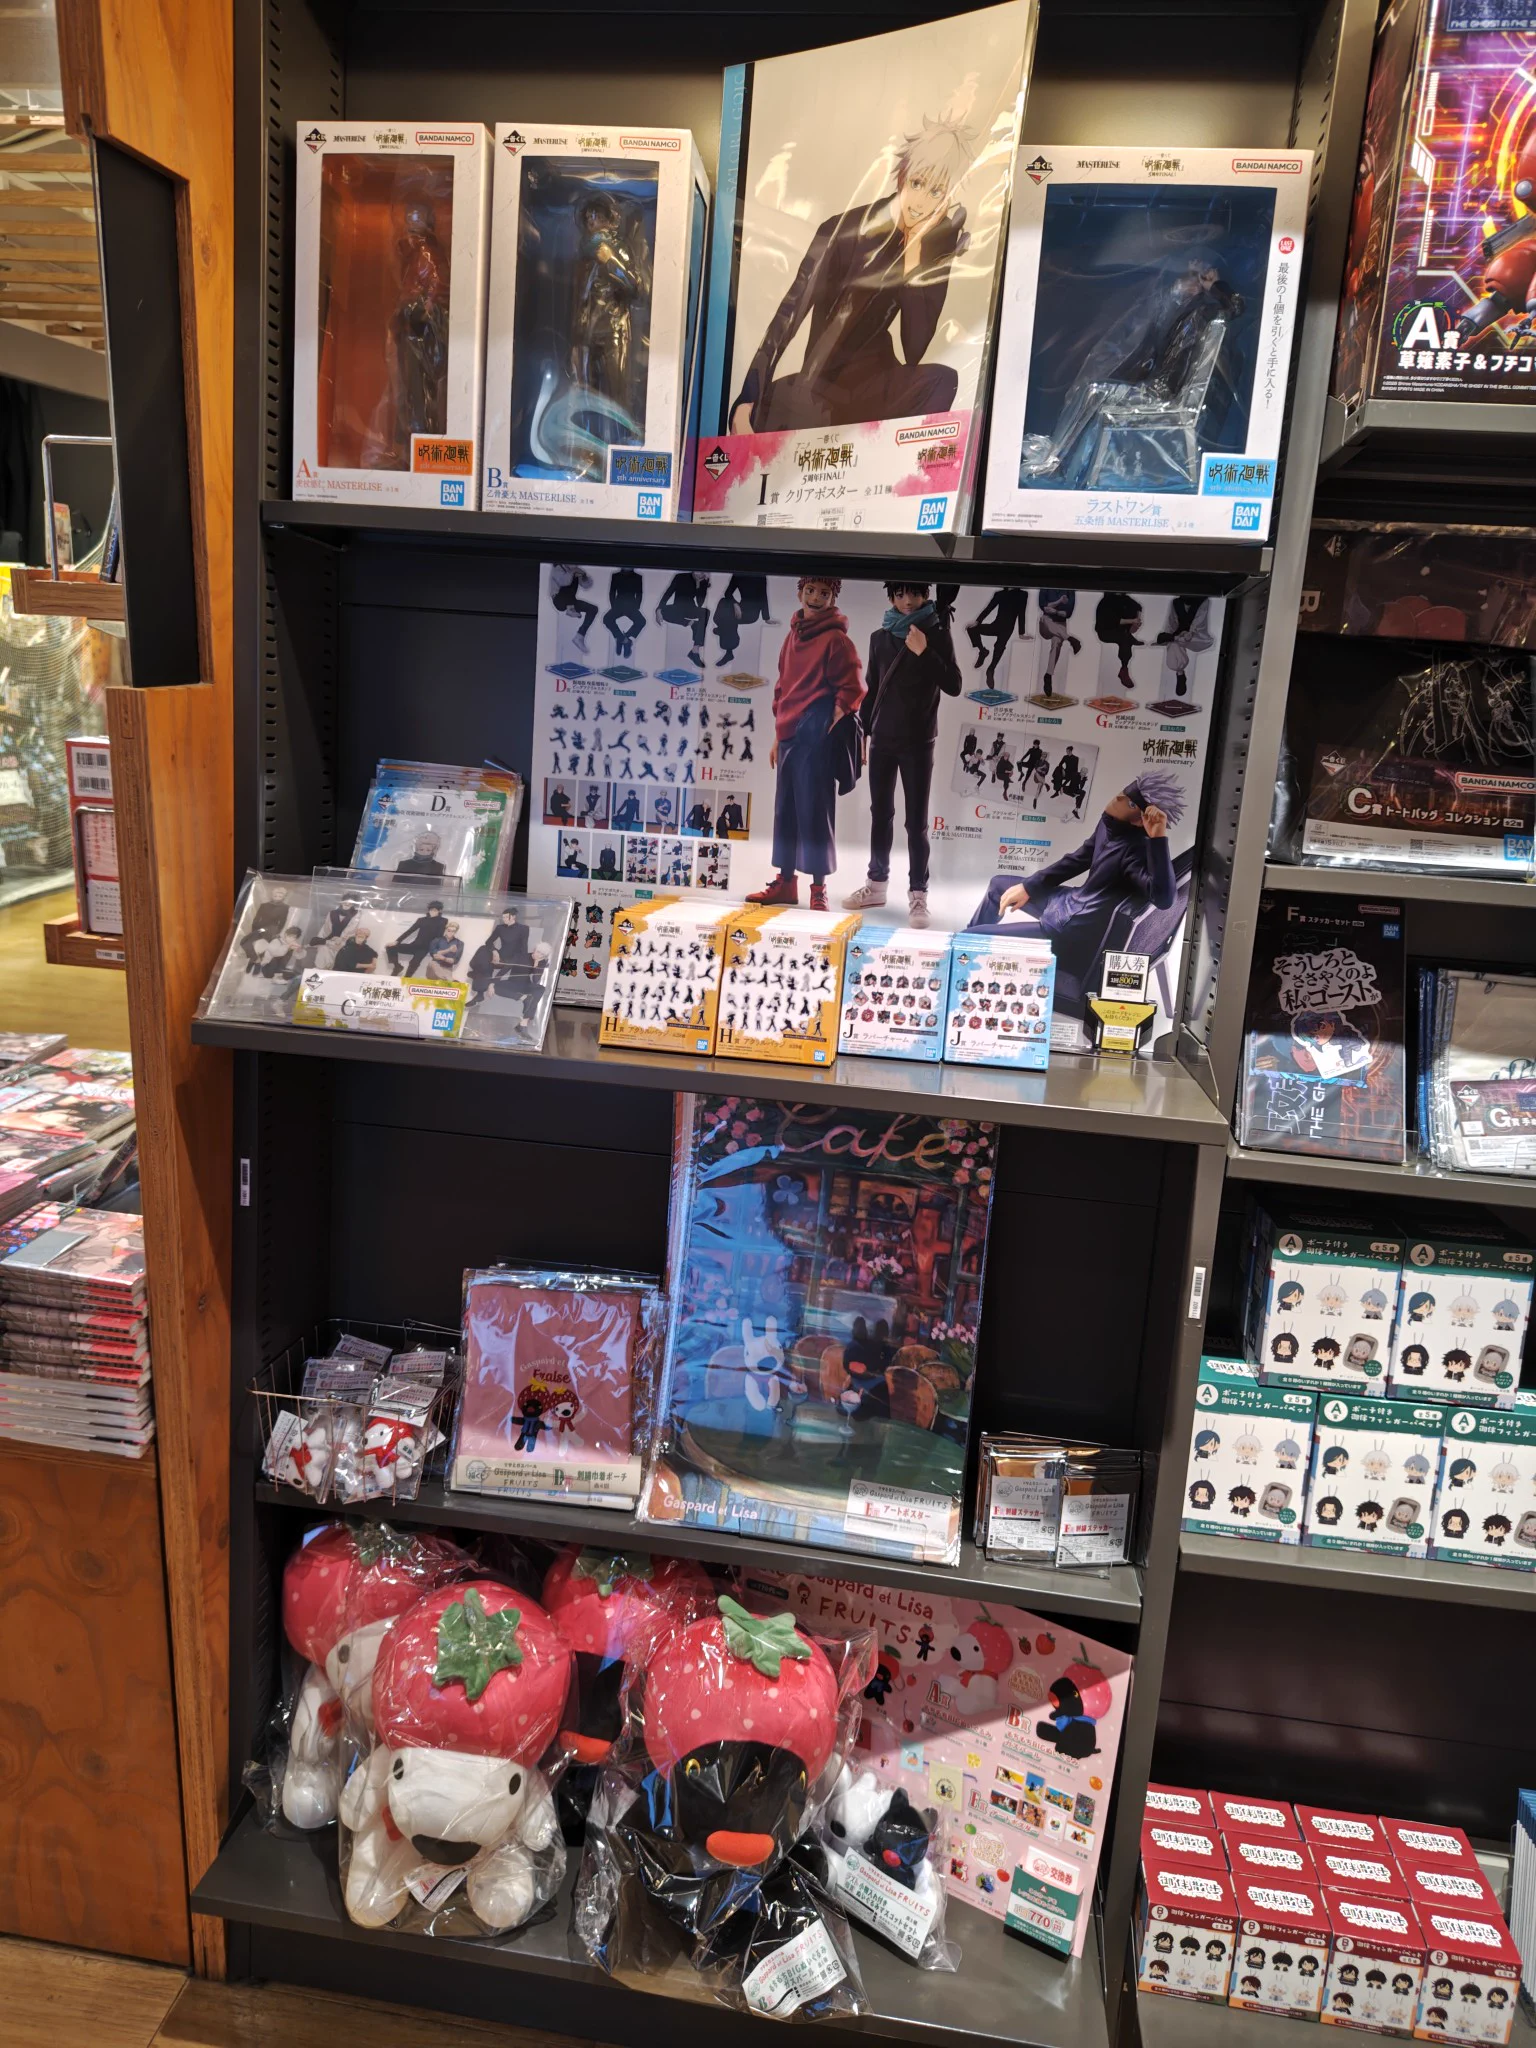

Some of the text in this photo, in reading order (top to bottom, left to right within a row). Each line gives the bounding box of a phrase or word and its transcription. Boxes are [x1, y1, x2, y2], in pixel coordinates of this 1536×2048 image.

[446, 135, 472, 143] NAMCO
[1236, 162, 1299, 171] BANDAI NAMCO
[1402, 306, 1461, 349] A 賞
[899, 425, 956, 441] BANDAI NAMCO
[418, 444, 469, 464] 呪術廻戦
[296, 459, 312, 478] A
[1208, 463, 1271, 485] 呪術廻戦
[487, 468, 502, 488] B
[616, 475, 667, 485] 5th anniversary
[327, 480, 383, 492] MASTERLISE
[443, 484, 464, 494] BAN
[757, 473, 770, 506] I
[770, 493, 780, 504] 賞
[785, 487, 858, 504] クリアポスター
[442, 494, 459, 503] DAI
[518, 491, 577, 504] MASTERLISE
[639, 496, 661, 506] BAN
[639, 505, 657, 516] DAI
[922, 497, 945, 514] BAN
[1087, 498, 1162, 517] ラストワン賞
[1236, 506, 1259, 517] BAN
[919, 510, 938, 526] DAI
[1107, 516, 1169, 529] MASTERLISE
[1235, 517, 1253, 527] DAI
[555, 679, 567, 693] D
[670, 686, 681, 700] E
[978, 707, 989, 720] F
[1096, 714, 1108, 729] G
[1142, 739, 1198, 760] 呪術廻戦
[1155, 758, 1195, 767] anniversary
[701, 766, 713, 781] H
[1461, 776, 1535, 790] BANDAI NAMCO
[430, 794, 446, 811] D
[1347, 787, 1501, 826] C 賞 トートバッグ コレクション
[975, 805, 987, 819] C
[933, 816, 945, 831] B
[951, 832, 983, 840] MASTERLISE
[1288, 907, 1300, 921] F
[1109, 954, 1145, 972] 購入券
[1275, 951, 1356, 975] そうしろと
[1292, 965, 1374, 988] ささやくのよ
[411, 987, 457, 998] BANDAI NAMCO
[1283, 981, 1379, 1011] 私のゴーストが
[341, 998, 356, 1017] C
[435, 1011, 455, 1021] BAN
[434, 1020, 448, 1029] DAI
[605, 1017, 617, 1032] H
[843, 1024, 854, 1039] J
[720, 1028, 733, 1044] H
[950, 1031, 961, 1046] J
[1490, 1107, 1512, 1128] G
[1286, 1236, 1296, 1248] A
[1307, 1238, 1349, 1249] ポーチ付き
[1417, 1246, 1428, 1259] A
[1439, 1248, 1482, 1260] ポーチ付き
[1202, 1386, 1213, 1399] A
[1222, 1389, 1263, 1401] ポーチ付き
[1331, 1402, 1342, 1415] A
[1351, 1405, 1393, 1416] ポーチ付き
[1458, 1414, 1470, 1428] A
[1480, 1416, 1522, 1429] ポーチ付き
[503, 1479, 539, 1488] FRUITS
[554, 1468, 565, 1486] D
[662, 1494, 758, 1520] Gaspard Lisa
[869, 1489, 895, 1501] Gaspard
[913, 1495, 949, 1511] FRUITS
[864, 1501, 932, 1520] E アートポスター
[993, 1506, 1000, 1515] F
[1064, 1524, 1070, 1533] F
[879, 1590, 933, 1620] et Lisa
[819, 1596, 912, 1645] FRUITS
[929, 1684, 941, 1706] A
[1007, 1706, 1021, 1728] B
[970, 1790, 981, 1809] E
[1050, 1866, 1073, 1886] 交換券
[897, 1893, 931, 1917] FRUITS
[1157, 1907, 1164, 1915] B
[1248, 1922, 1256, 1931] B
[795, 1929, 824, 1956] FRUITS
[1341, 1938, 1349, 1947] B
[1436, 1952, 1444, 1961] B
